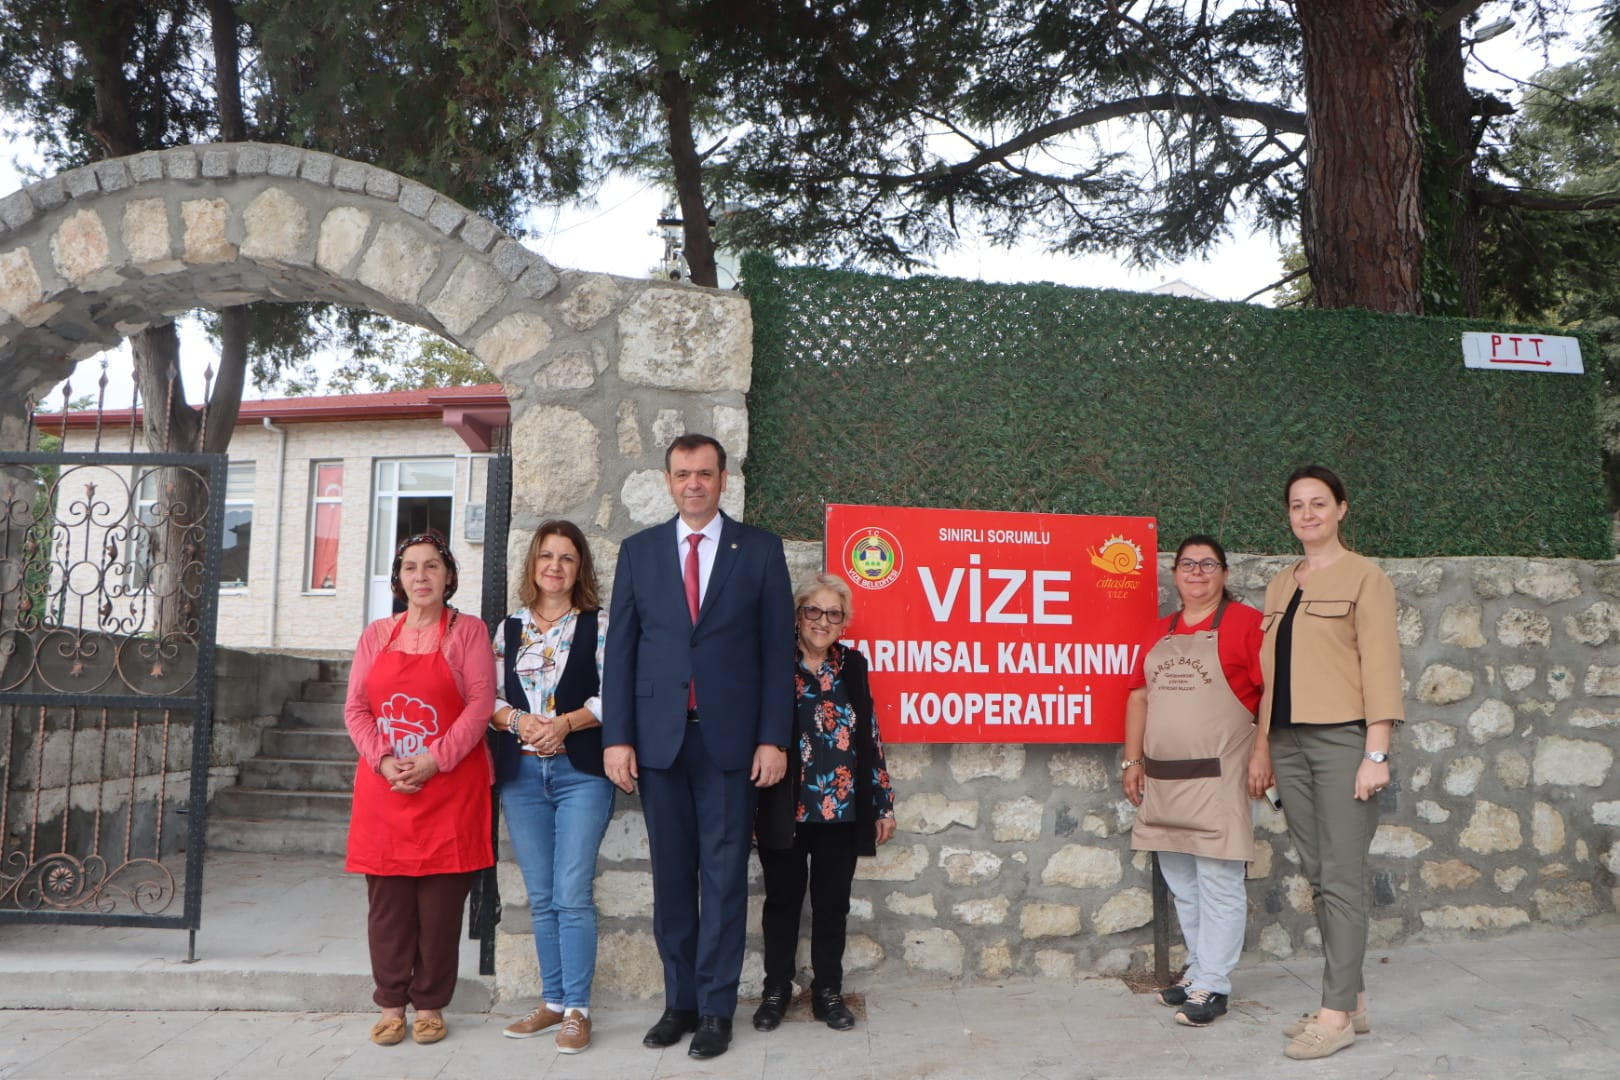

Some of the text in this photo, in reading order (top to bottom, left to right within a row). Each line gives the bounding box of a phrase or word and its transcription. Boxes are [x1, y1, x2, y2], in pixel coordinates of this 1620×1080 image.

[1491, 335, 1544, 357] PTT
[939, 528, 1050, 545] SINIRLI SORUMLU
[917, 554, 1073, 625] VİZE
[900, 685, 1092, 725] KOOPERATİFİ
